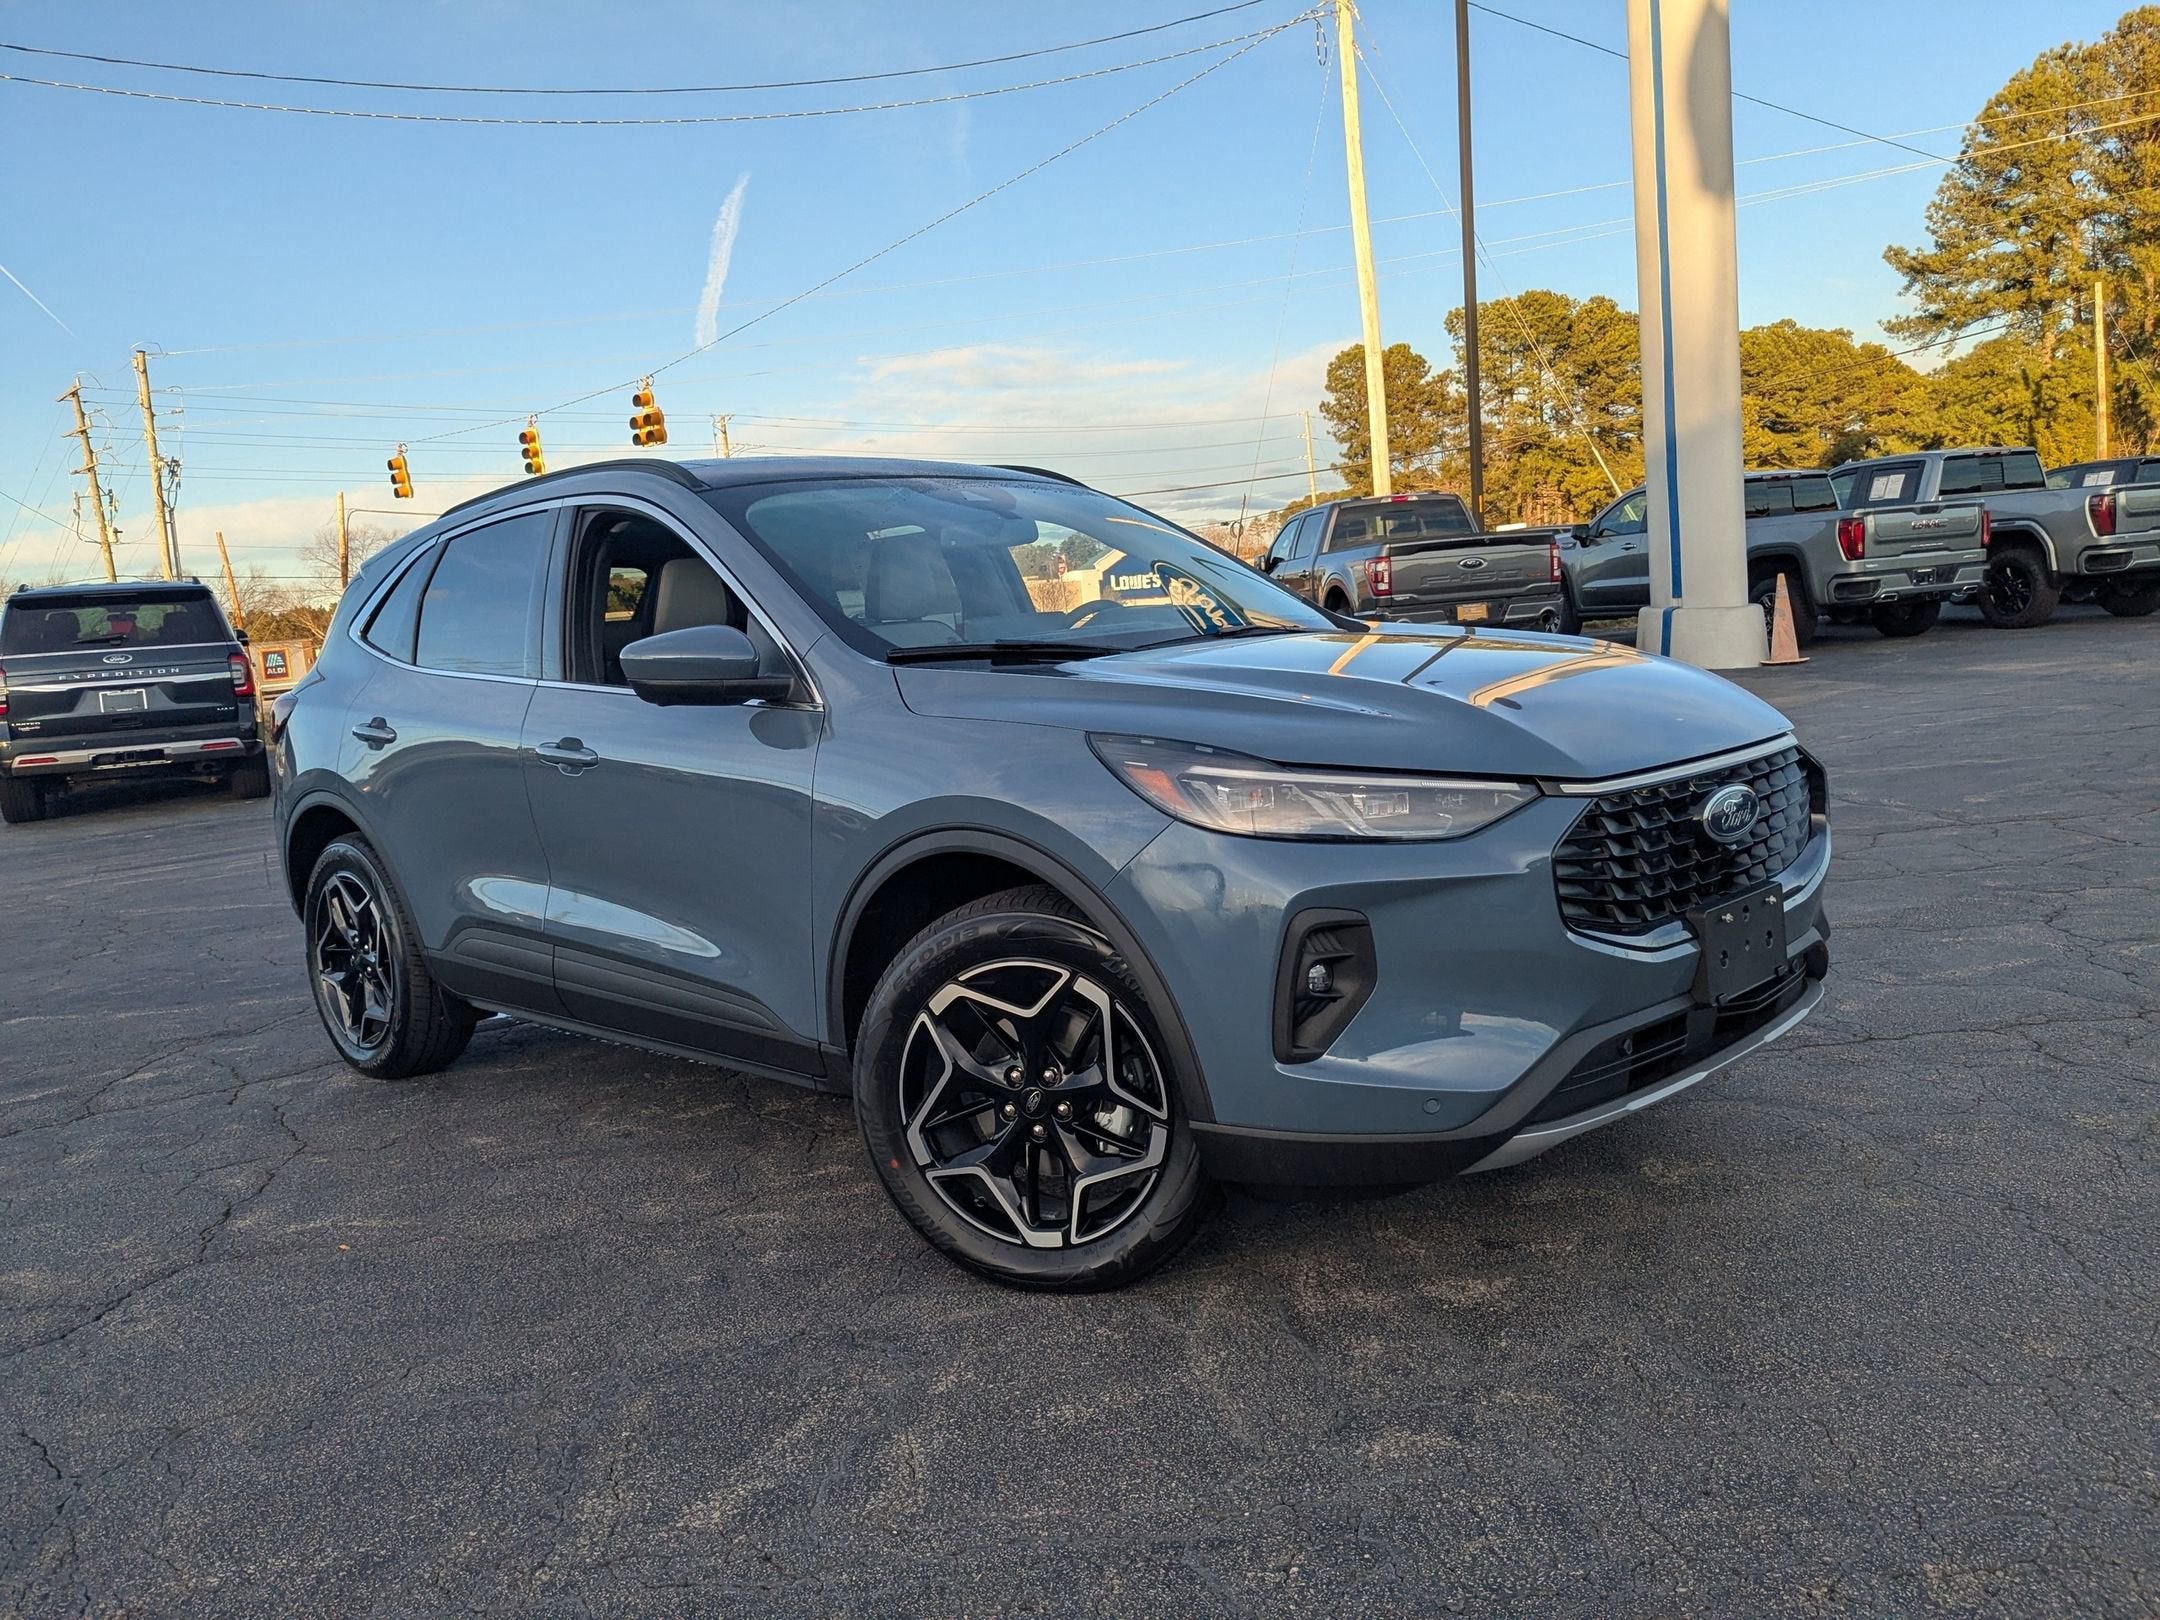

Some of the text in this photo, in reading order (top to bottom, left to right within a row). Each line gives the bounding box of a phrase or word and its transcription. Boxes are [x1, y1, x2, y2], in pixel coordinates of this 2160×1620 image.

[1109, 572, 1161, 591] LOWE'S
[59, 667, 180, 681] EXPEDITION
[267, 667, 286, 675] ALDI
[1721, 797, 1752, 830] Ford
